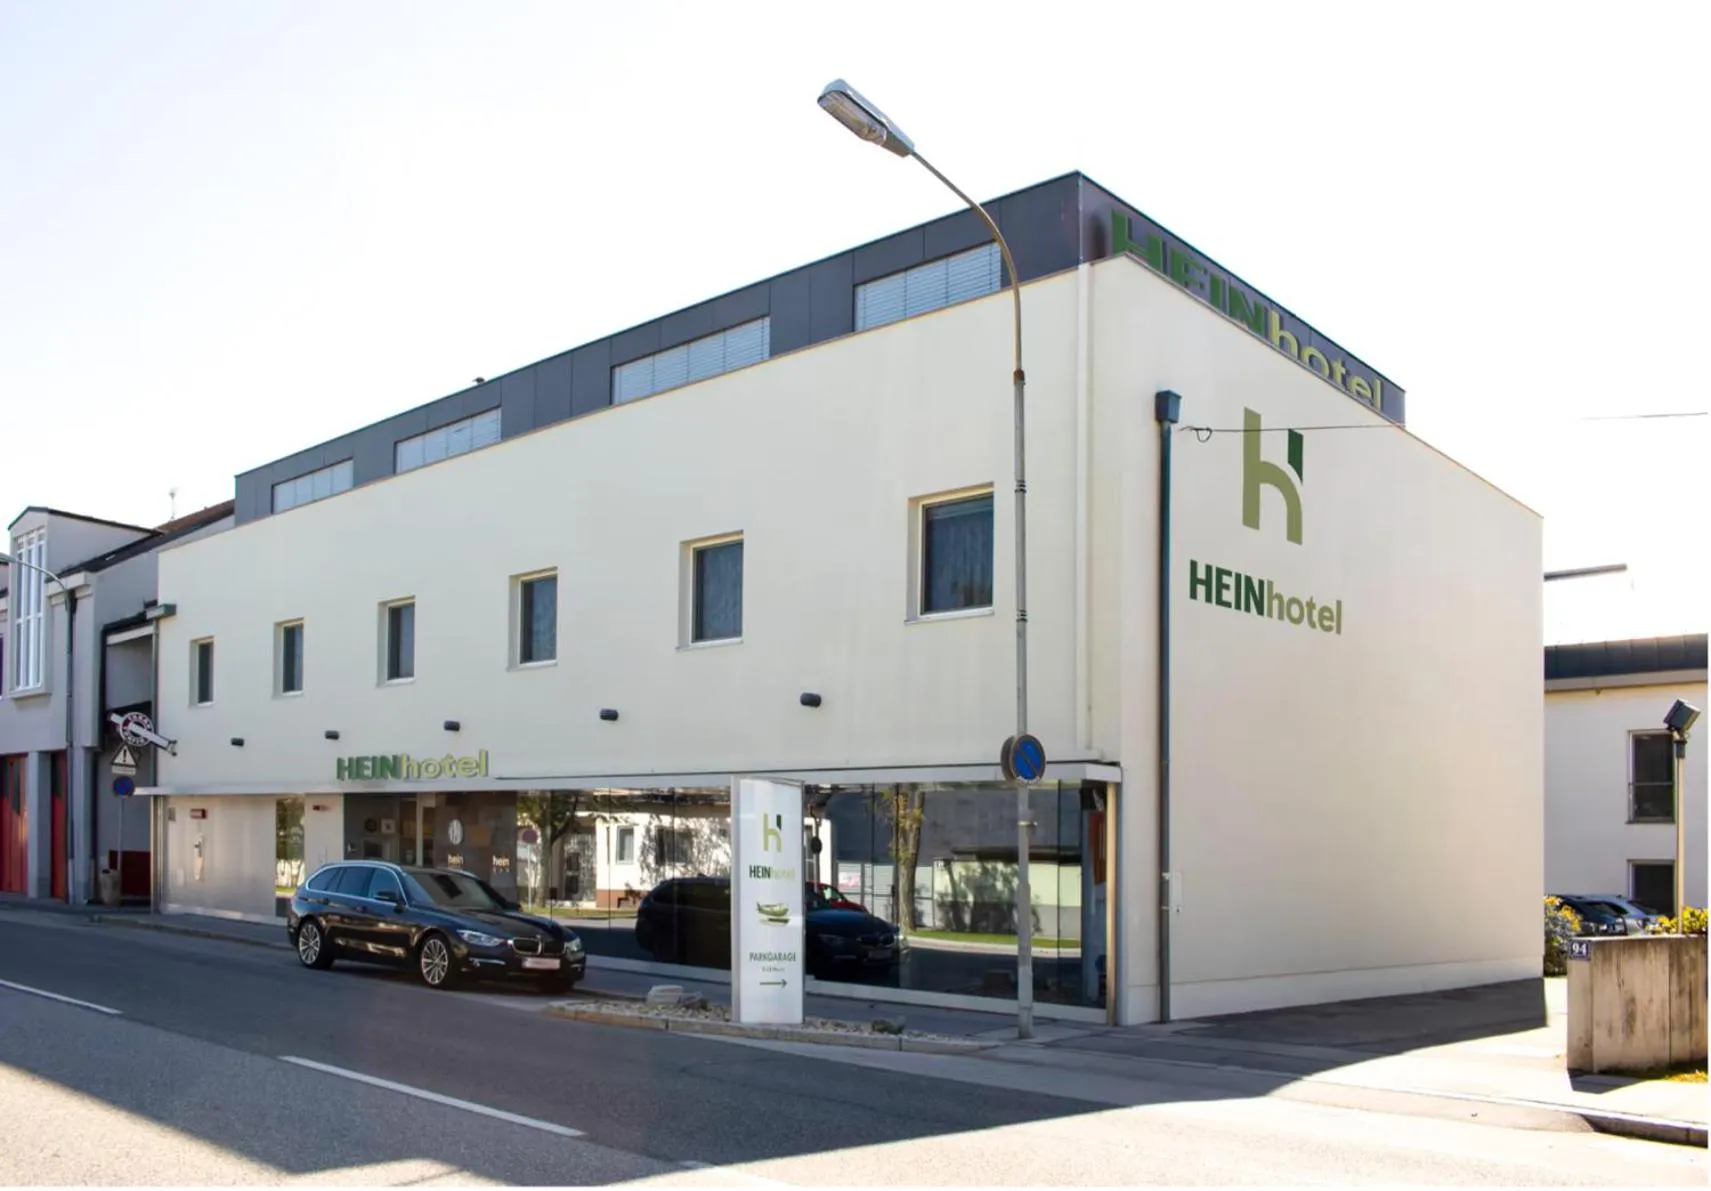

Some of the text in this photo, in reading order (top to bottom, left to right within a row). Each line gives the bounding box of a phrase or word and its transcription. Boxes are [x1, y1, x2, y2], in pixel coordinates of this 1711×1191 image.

[1189, 559, 1342, 635] HEINhotel
[336, 748, 489, 779] HEINhotel
[749, 951, 796, 962] PARKGARAGE
